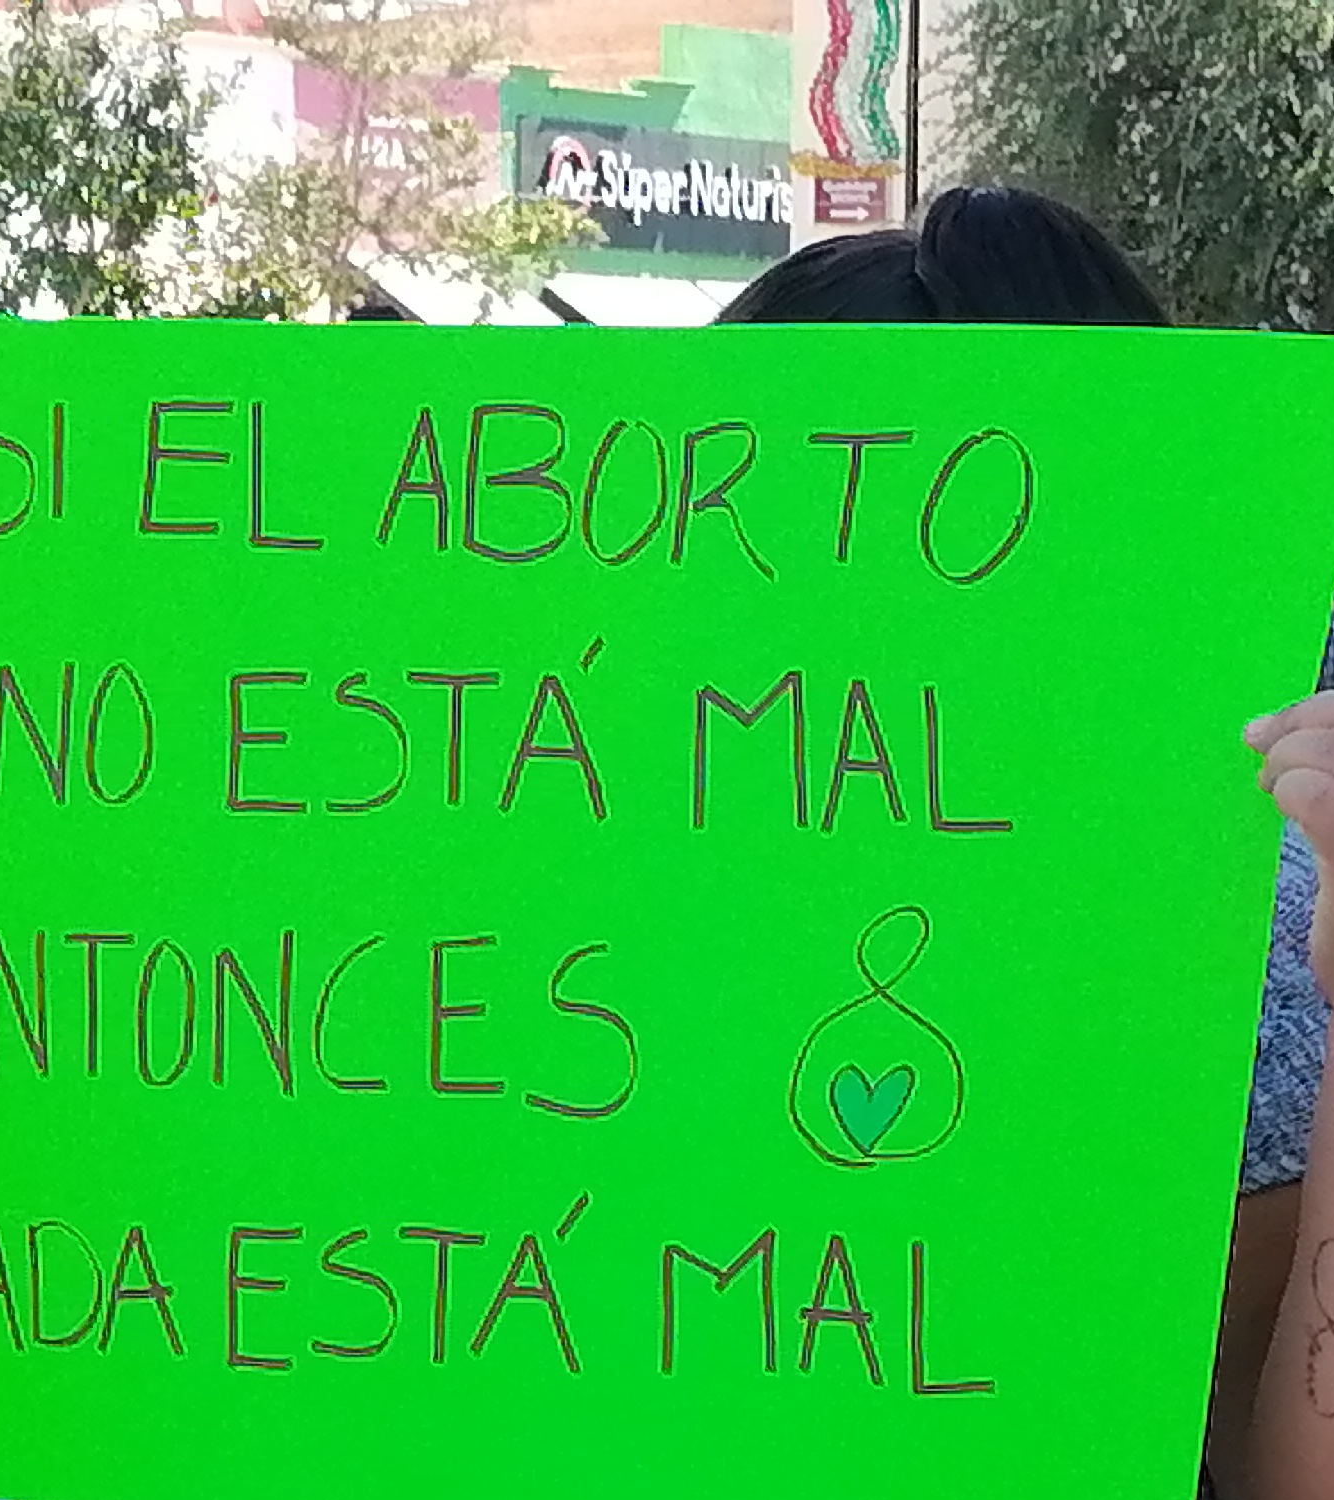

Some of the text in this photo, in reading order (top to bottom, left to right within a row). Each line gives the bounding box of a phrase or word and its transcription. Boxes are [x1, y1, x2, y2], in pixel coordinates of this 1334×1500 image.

[139, 400, 324, 550] EL
[375, 401, 1035, 586] ABORTO
[227, 636, 607, 822] ESTÁ
[692, 670, 1013, 834] MAL
[225, 1191, 589, 1375] ESTÁ
[659, 1227, 996, 1396] MAL
